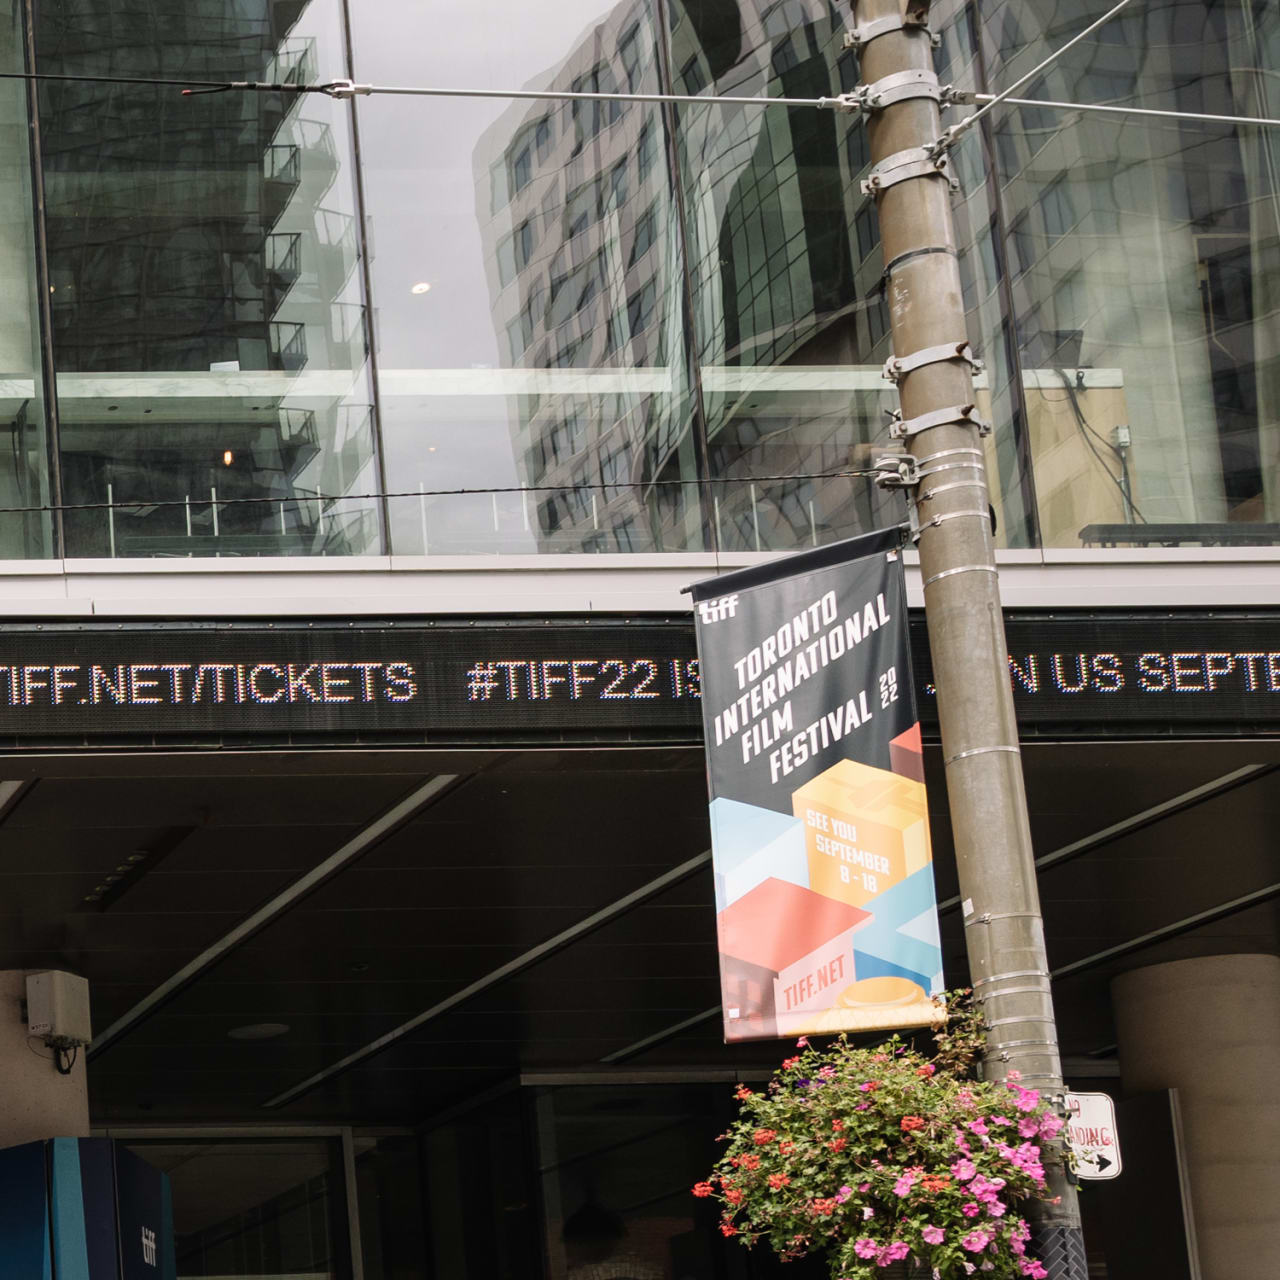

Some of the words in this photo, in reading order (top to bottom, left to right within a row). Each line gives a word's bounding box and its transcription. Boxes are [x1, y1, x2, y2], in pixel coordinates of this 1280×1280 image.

[698, 594, 739, 624] tiff
[734, 590, 838, 690] TORONTO
[467, 659, 659, 701] #TIFF22
[714, 593, 891, 747] INTERNATIONAL
[880, 667, 897, 691] 20
[1051, 653, 1125, 693] US
[881, 685, 899, 710] 22
[741, 701, 793, 764] FILM
[770, 690, 873, 784] FESTIVAL
[806, 809, 829, 833] SEE
[830, 817, 857, 842] YOU
[815, 834, 890, 876] SEPTEMBER
[840, 864, 850, 884] 8
[862, 872, 878, 893] 18
[784, 954, 845, 1011] TIFF.NET
